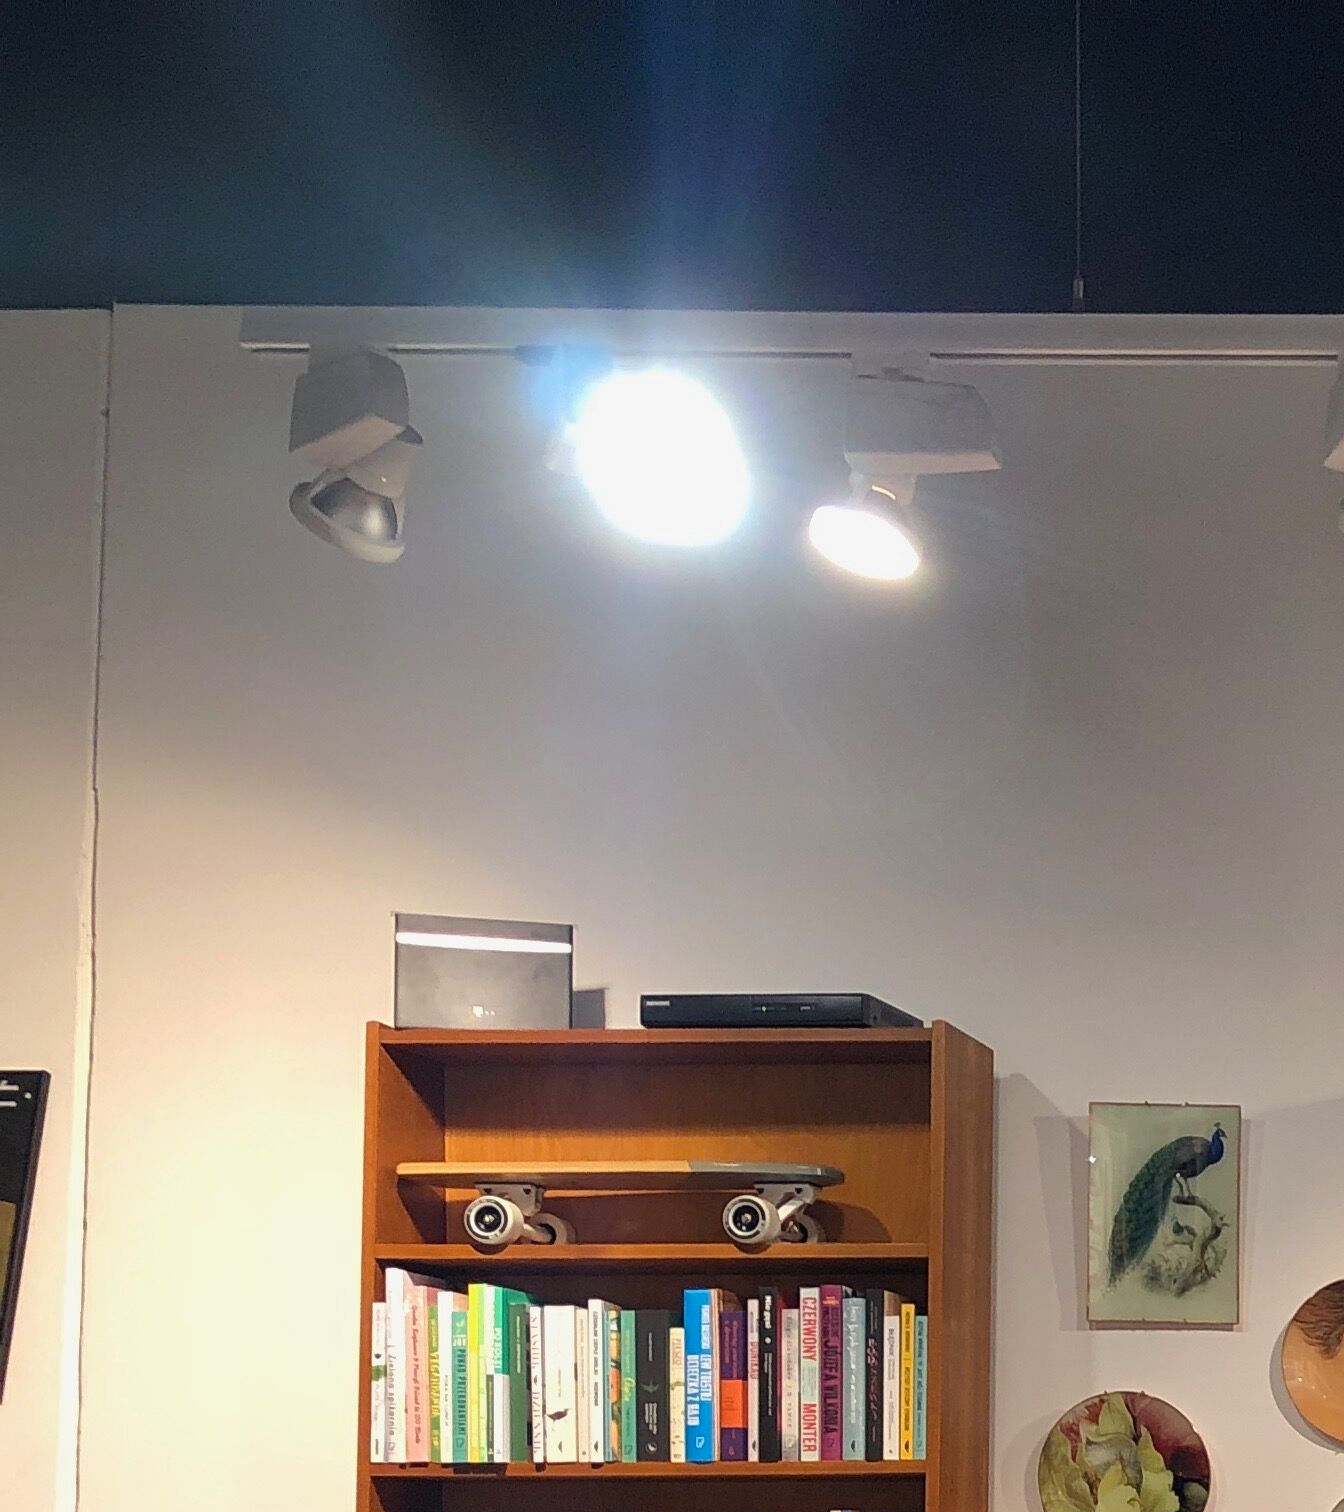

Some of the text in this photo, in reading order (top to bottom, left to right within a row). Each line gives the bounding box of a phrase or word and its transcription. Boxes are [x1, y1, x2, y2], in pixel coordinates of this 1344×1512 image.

[388, 1354, 396, 1390] Zielona
[802, 1297, 817, 1452] CZERWONY MONTER
[824, 1340, 841, 1381] JÓZEFA
[532, 1391, 540, 1454] DZIENNIK
[688, 1404, 700, 1426] RAJU
